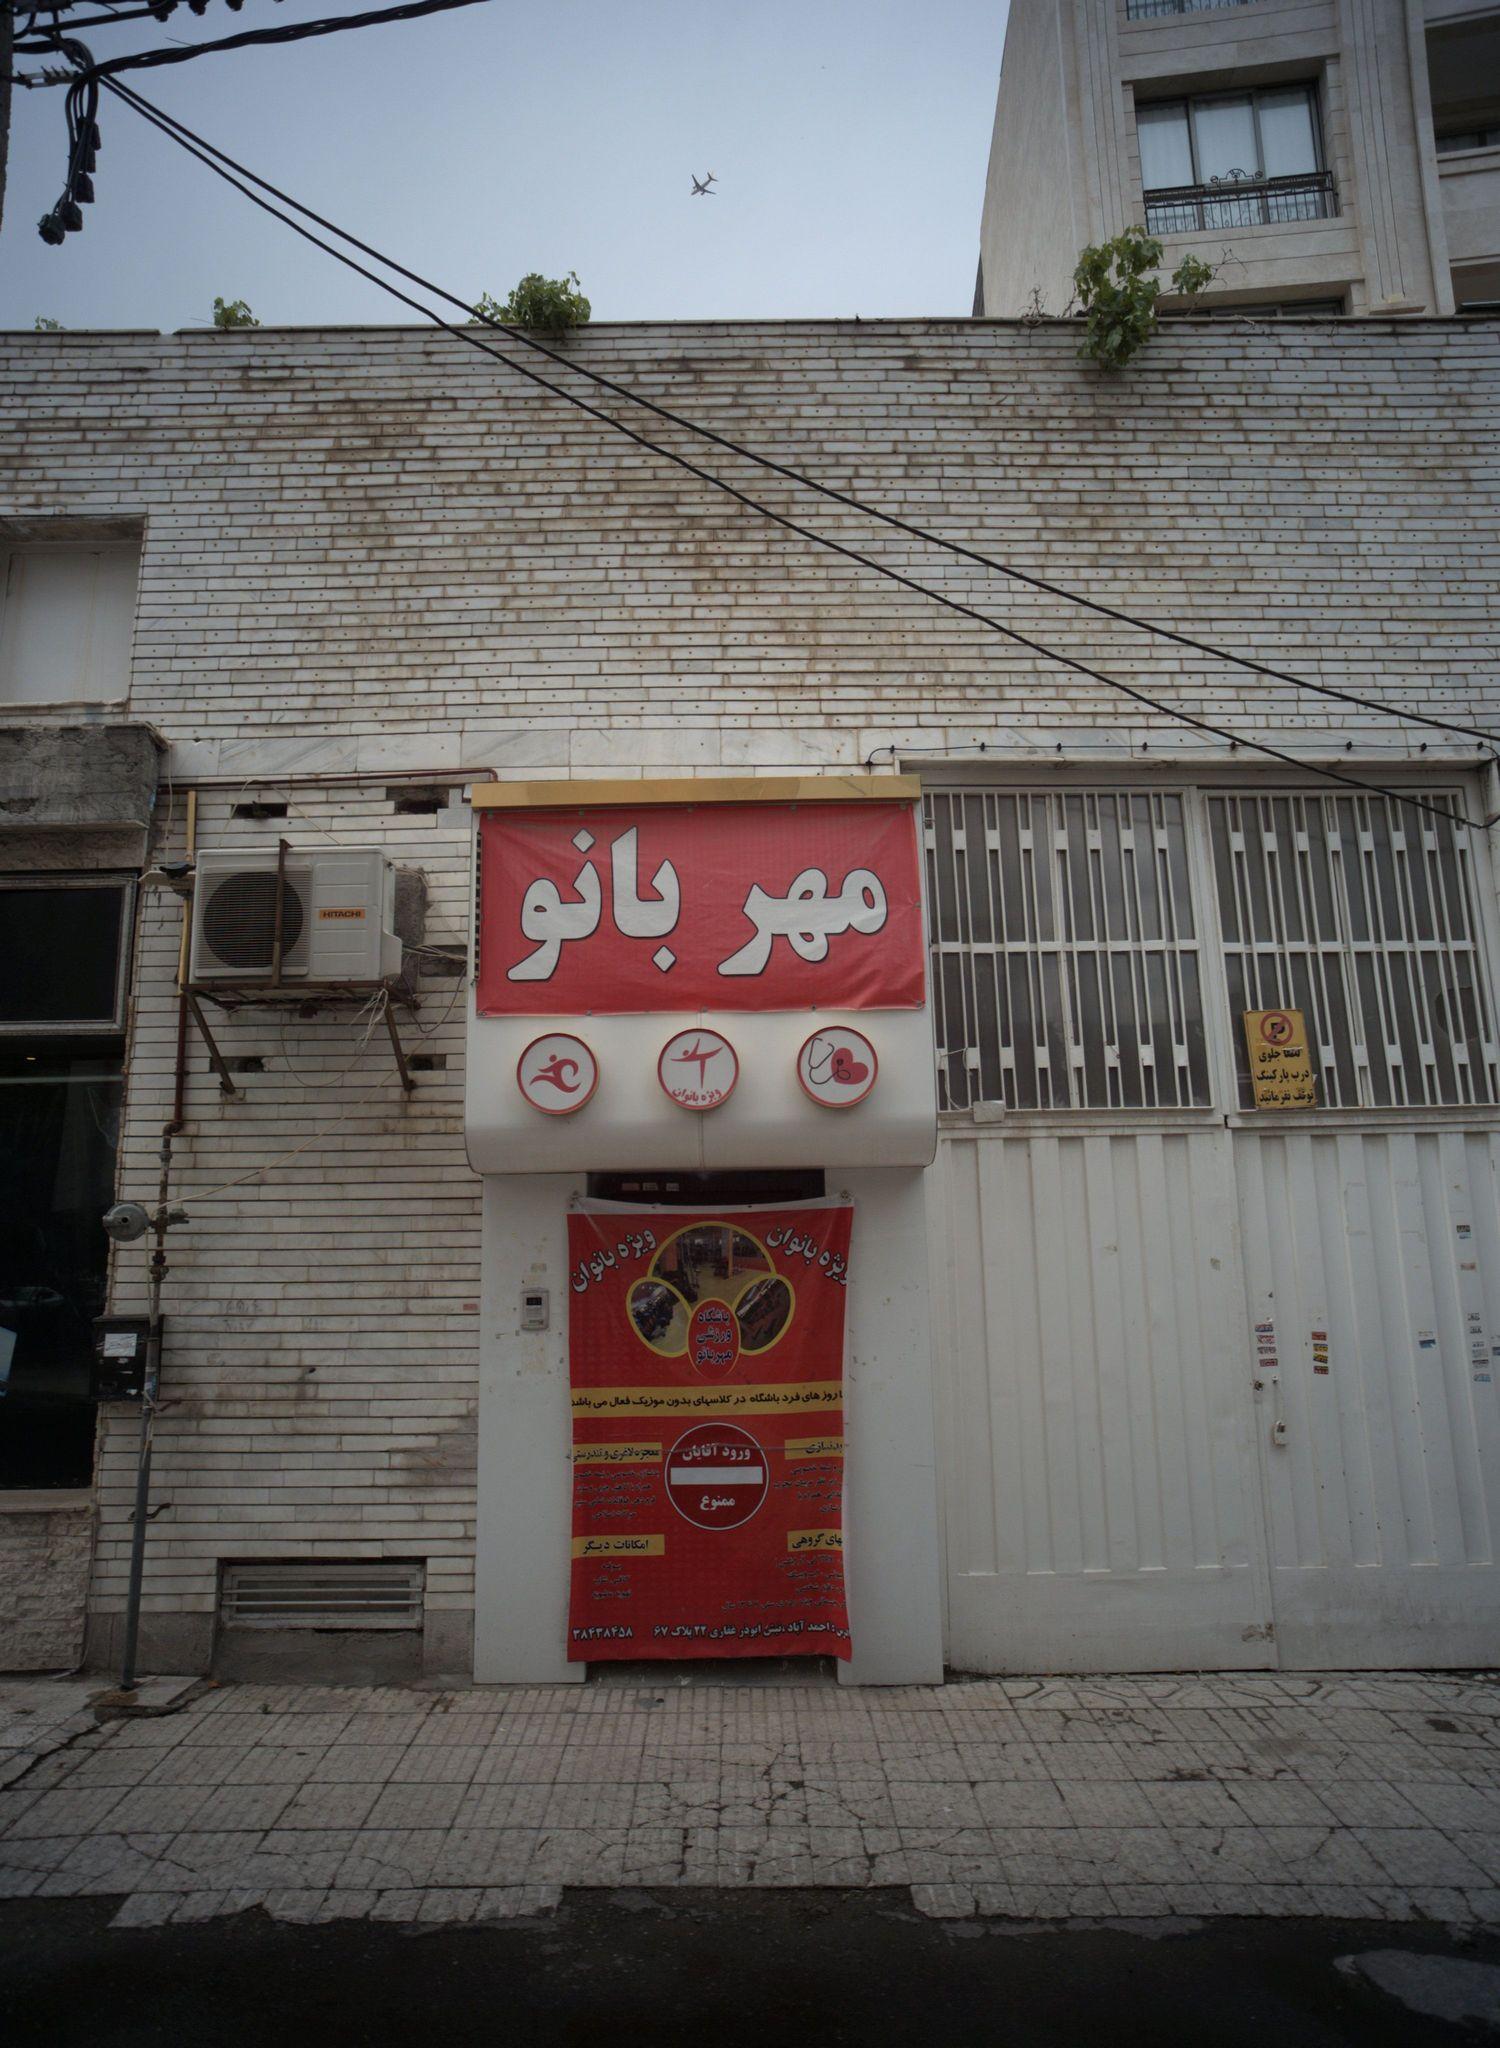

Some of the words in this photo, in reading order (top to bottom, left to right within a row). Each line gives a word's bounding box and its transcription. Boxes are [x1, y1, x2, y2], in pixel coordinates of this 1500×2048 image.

[506, 825, 681, 982] بانو
[323, 910, 361, 918] HITACHI
[717, 867, 888, 977] مهر
[1258, 1048, 1281, 1062] جلوی
[1291, 1070, 1309, 1082] درب
[672, 1088, 699, 1104] بانوان
[701, 1089, 721, 1103] ویژه
[616, 1229, 656, 1259] ویژه
[766, 1228, 818, 1265] بانوان
[571, 1249, 619, 1292] بانوان
[696, 1327, 731, 1343] ورزشی
[609, 1395, 631, 1407] فعال
[632, 1396, 665, 1408] موزیک
[666, 1396, 691, 1407] بدون
[734, 1397, 746, 1405] در
[750, 1393, 779, 1404] باشگاه
[782, 1392, 800, 1403] فرد
[802, 1390, 820, 1402] های
[822, 1390, 837, 1402] روز
[593, 1399, 608, 1408] می
[722, 1446, 751, 1461] ورود
[700, 1495, 735, 1510] ممنوع
[613, 1539, 648, 1552] امکانات
[792, 1533, 825, 1549] گروهی
[825, 1534, 843, 1546] های
[787, 1619, 804, 1635] آباد
